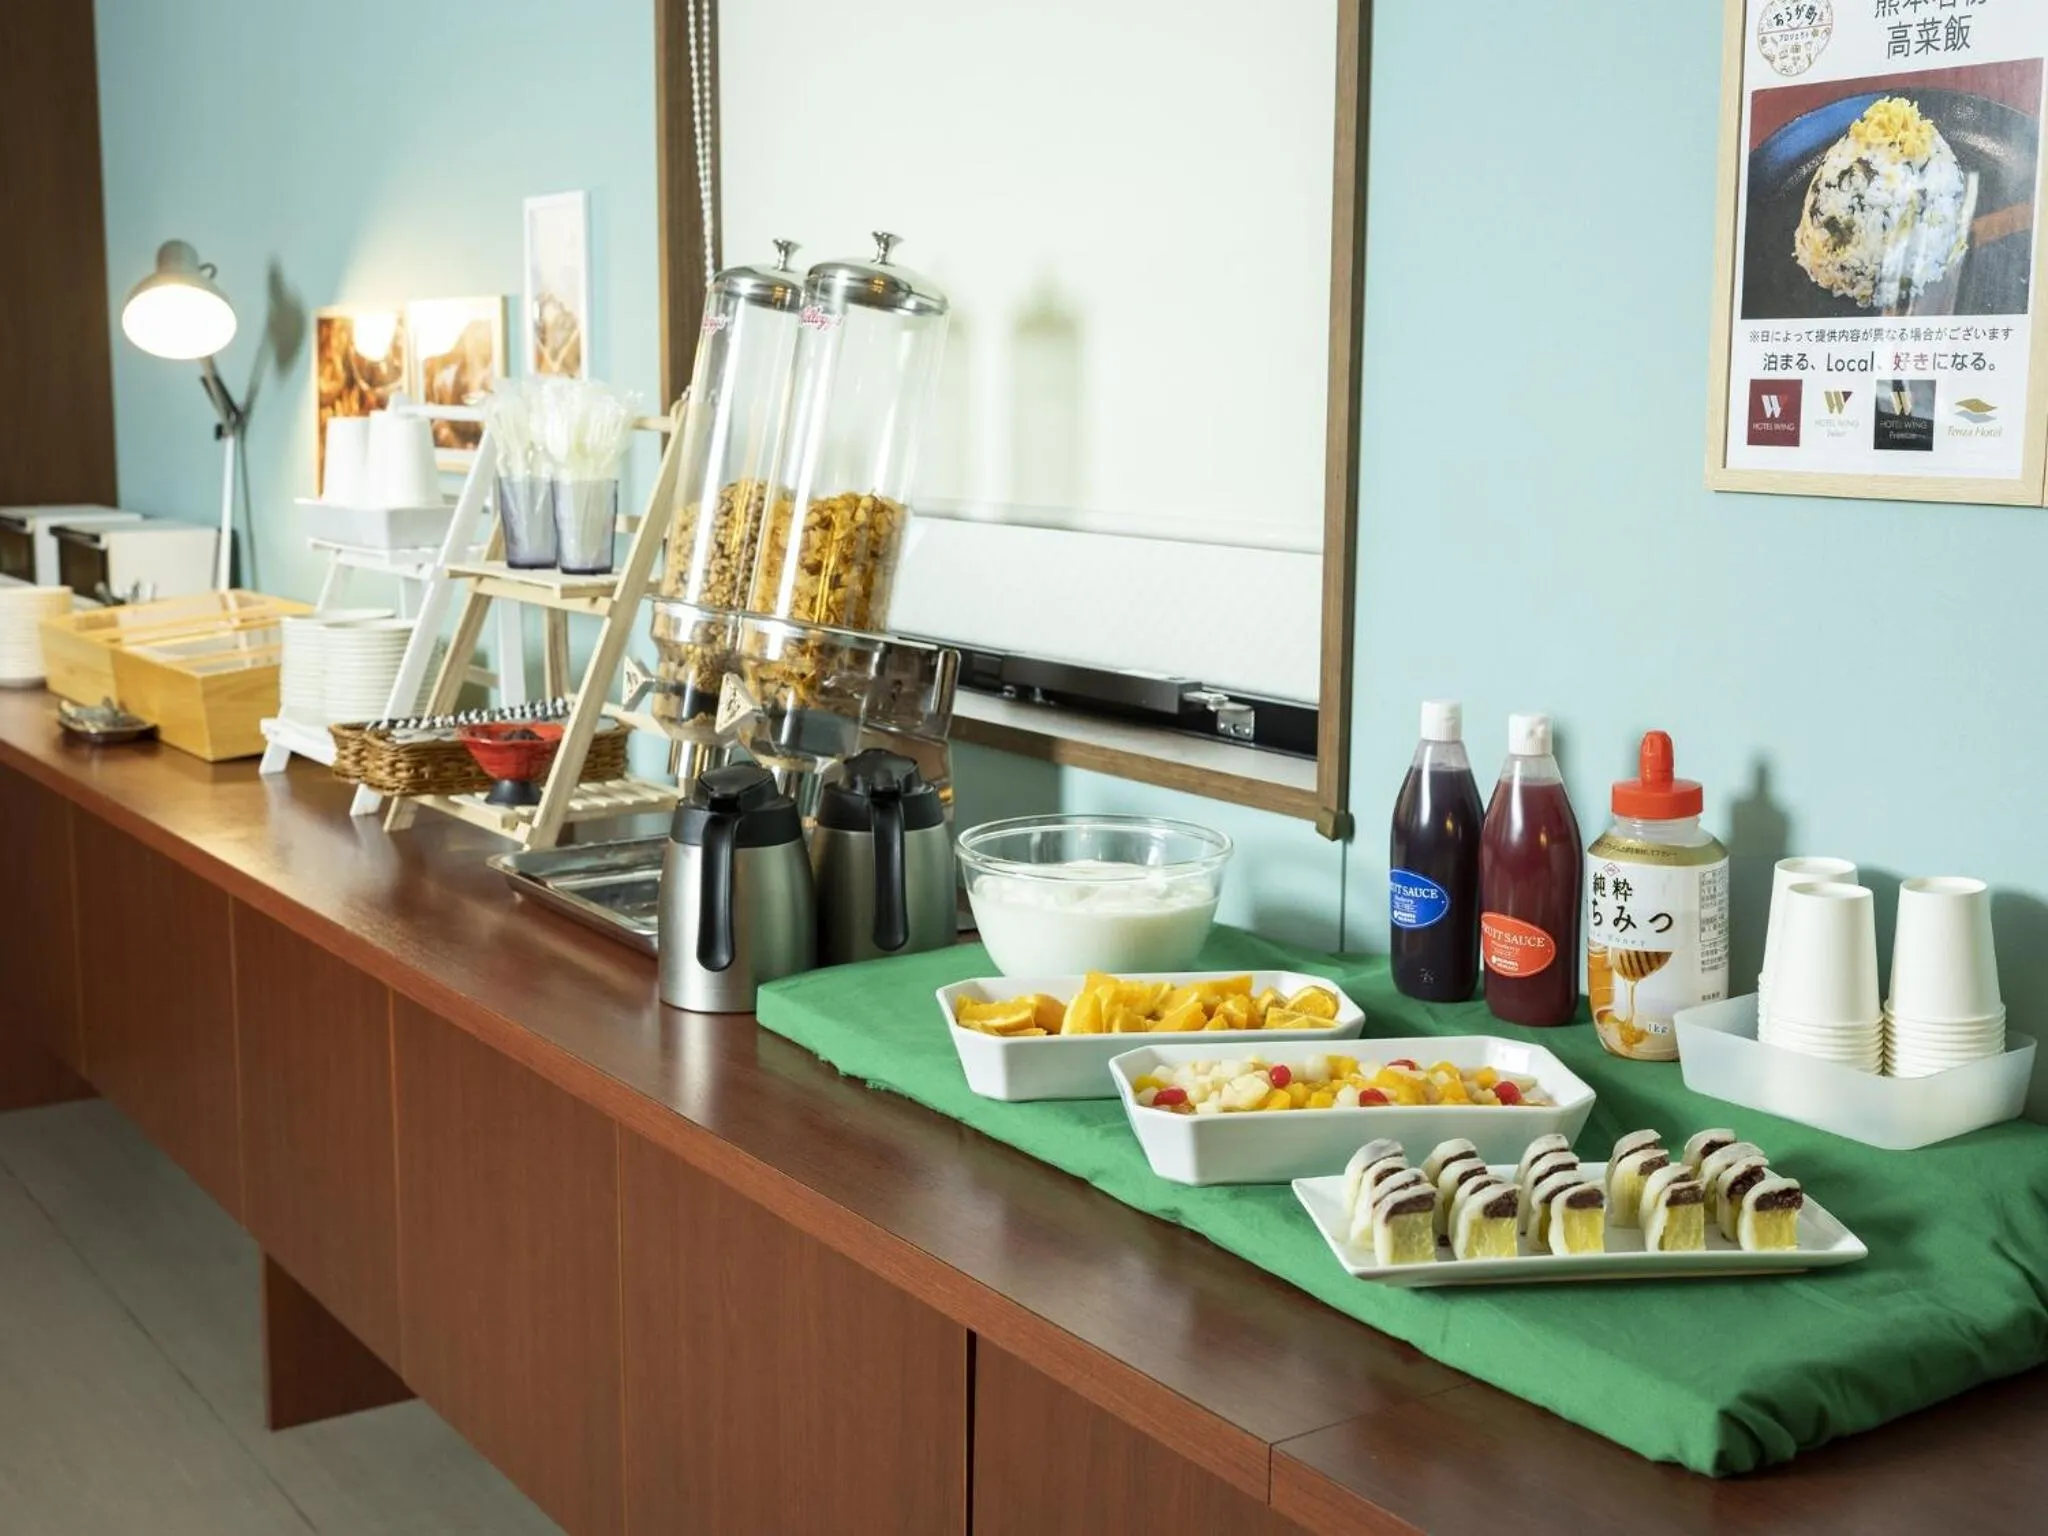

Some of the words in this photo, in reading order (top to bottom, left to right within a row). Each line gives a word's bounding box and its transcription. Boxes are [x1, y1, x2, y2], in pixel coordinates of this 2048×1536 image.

[1886, 14, 1973, 60] 高菜飯
[1752, 422, 1773, 431] HOTEL
[1774, 422, 1795, 432] WING
[1904, 420, 1928, 430] WING
[1402, 885, 1439, 899] SAUCE
[1593, 872, 1633, 902] 純粋
[1592, 898, 1673, 934] ちみつ
[1504, 932, 1545, 947] SAUCE
